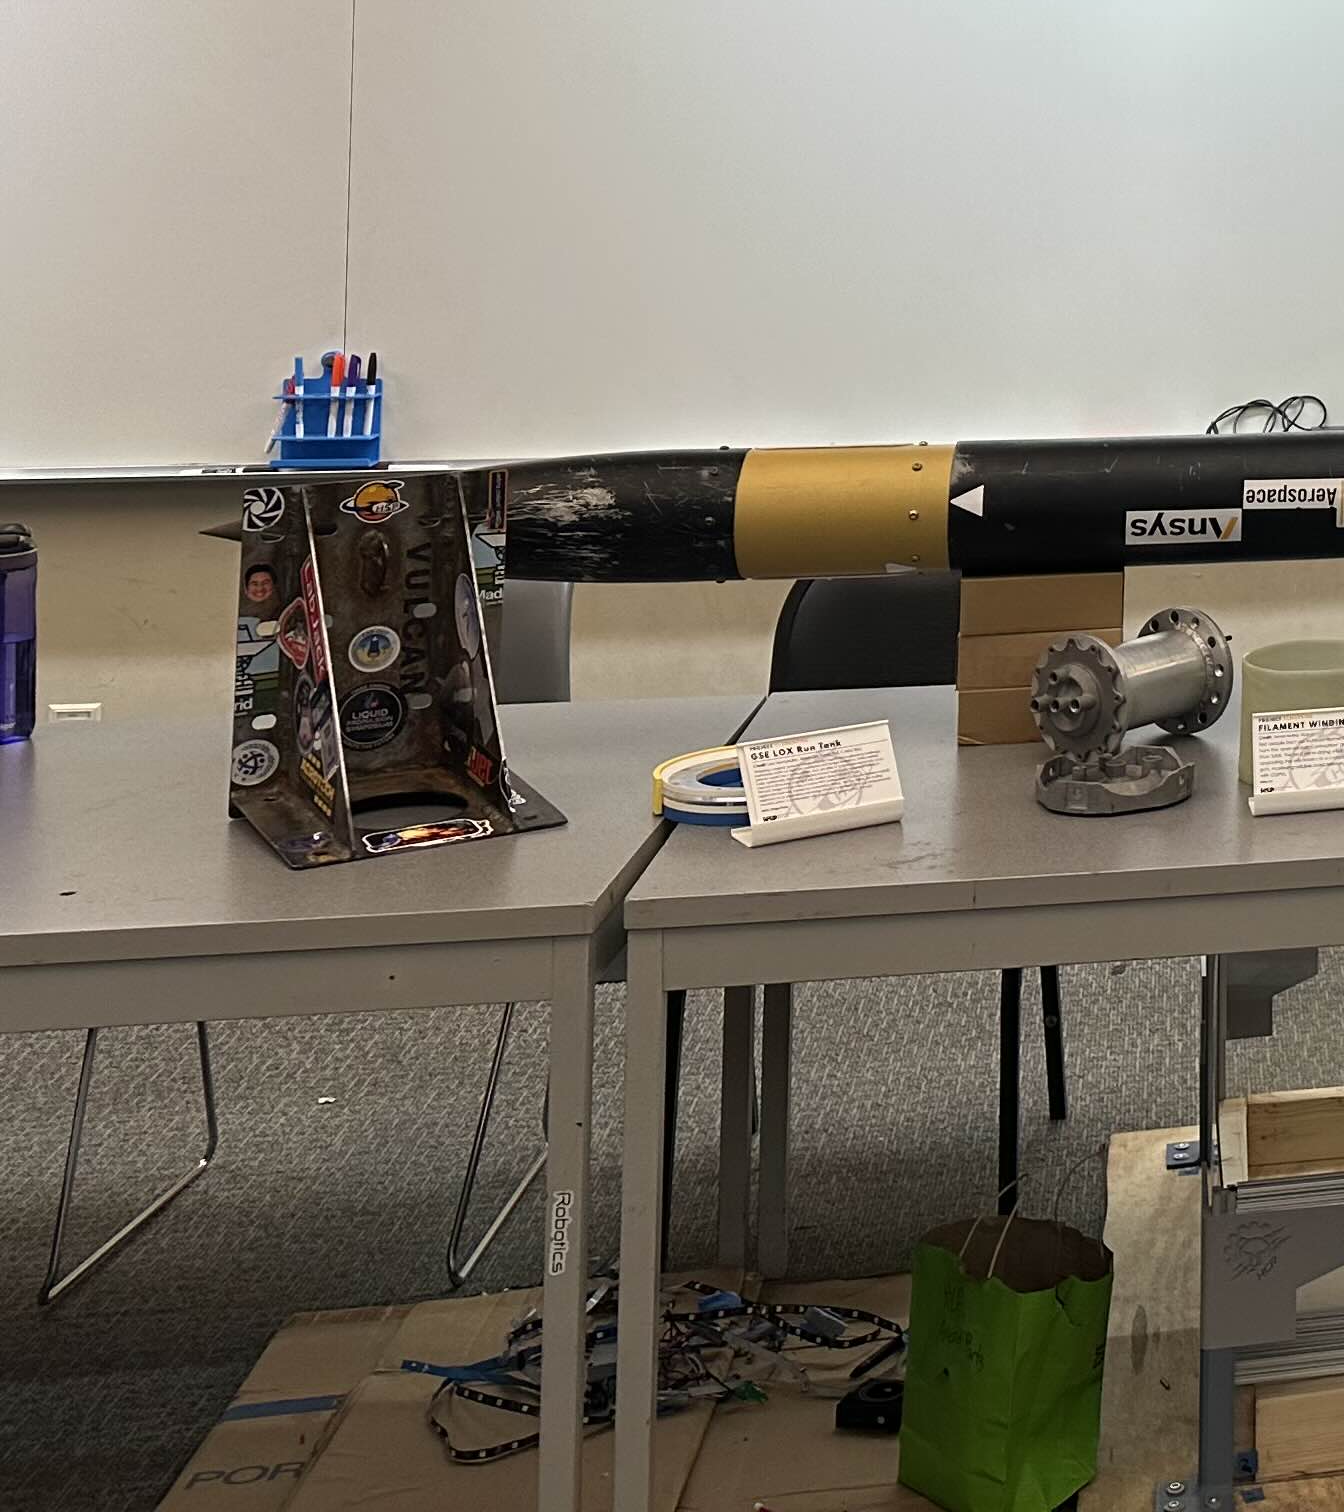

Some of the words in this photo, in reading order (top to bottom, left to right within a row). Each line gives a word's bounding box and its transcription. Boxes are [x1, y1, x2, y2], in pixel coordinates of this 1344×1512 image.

[1246, 484, 1337, 506] Aerospace
[376, 502, 399, 513] HSP
[1130, 512, 1239, 542] Ansys
[352, 708, 389, 719] LIQUID
[1258, 721, 1305, 731] FILAMENT
[751, 750, 770, 761] GSE
[773, 747, 794, 758] LOX
[796, 744, 816, 753] Run
[818, 739, 842, 750] Tank
[550, 1190, 574, 1275] Robotics
